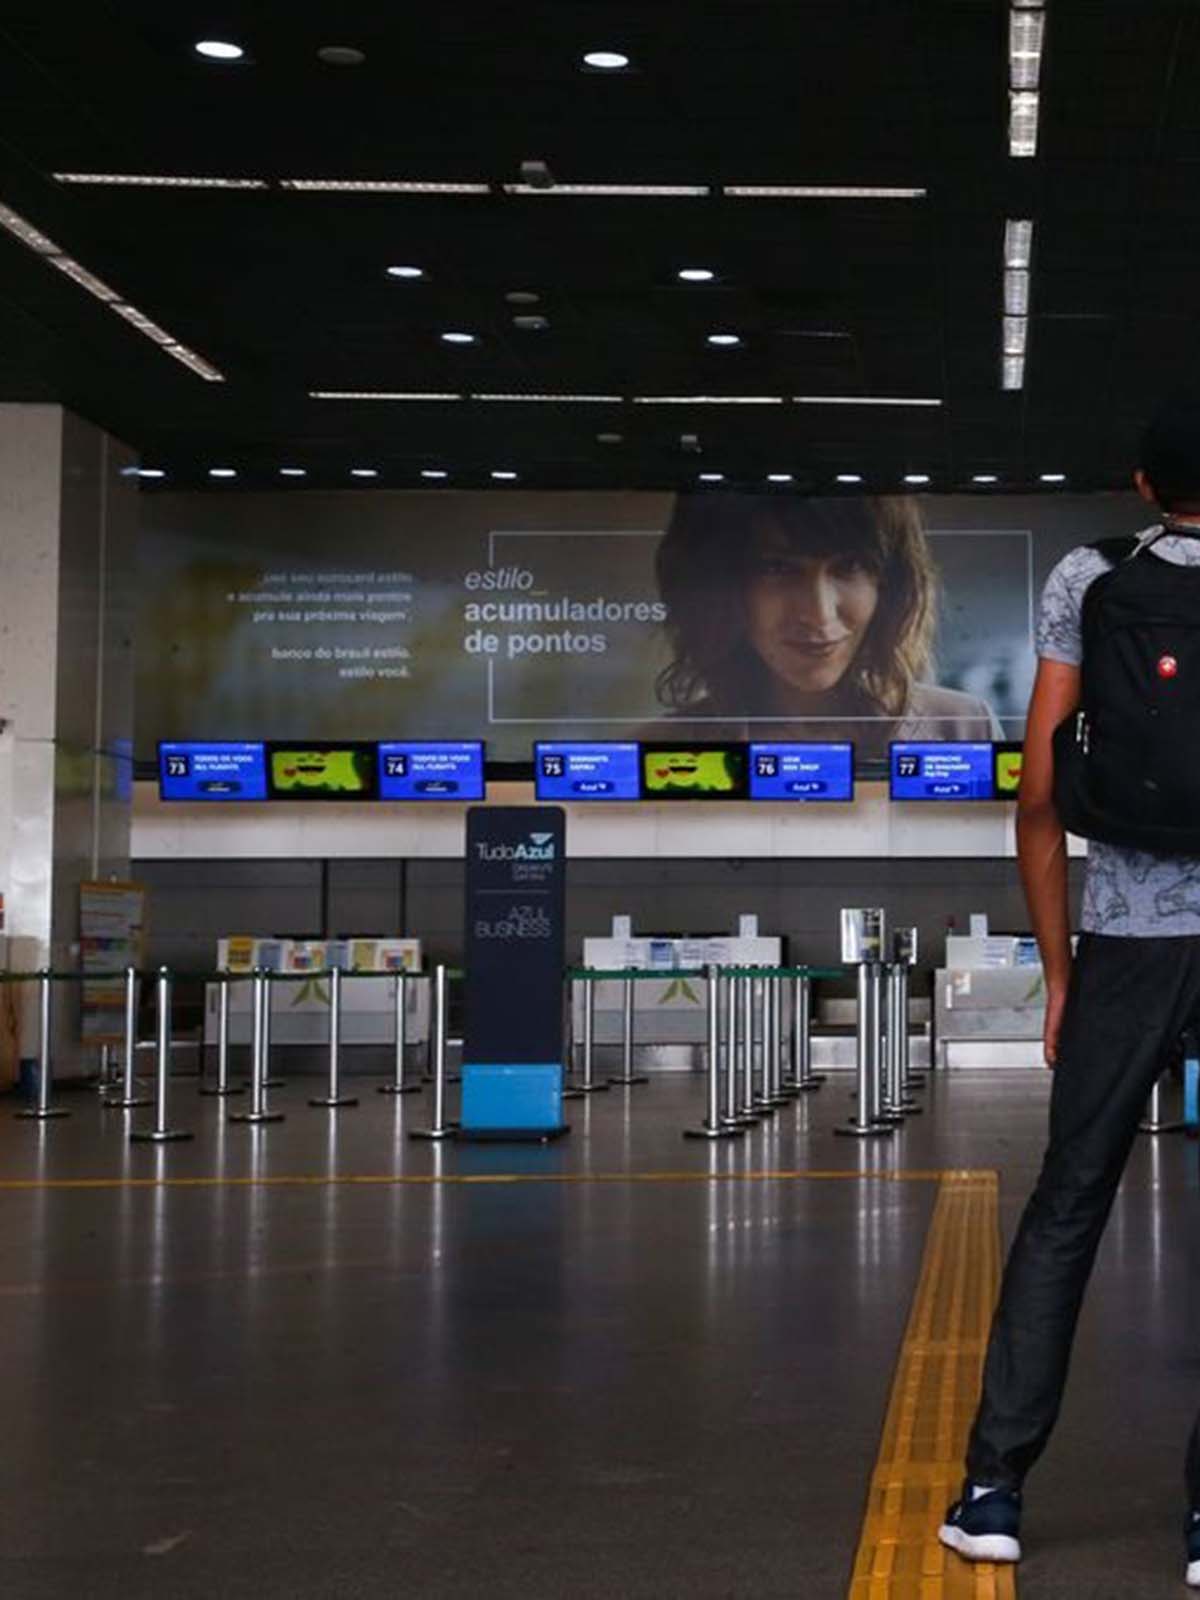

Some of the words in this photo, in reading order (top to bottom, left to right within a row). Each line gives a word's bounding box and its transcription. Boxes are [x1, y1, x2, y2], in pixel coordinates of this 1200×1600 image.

[464, 597, 667, 622] acumuladores
[464, 630, 499, 652] de
[507, 630, 607, 659] pontos
[168, 762, 187, 775] 73
[387, 762, 404, 775] 74
[543, 762, 562, 775] 75
[758, 762, 775, 775] 76
[900, 763, 916, 775] 77
